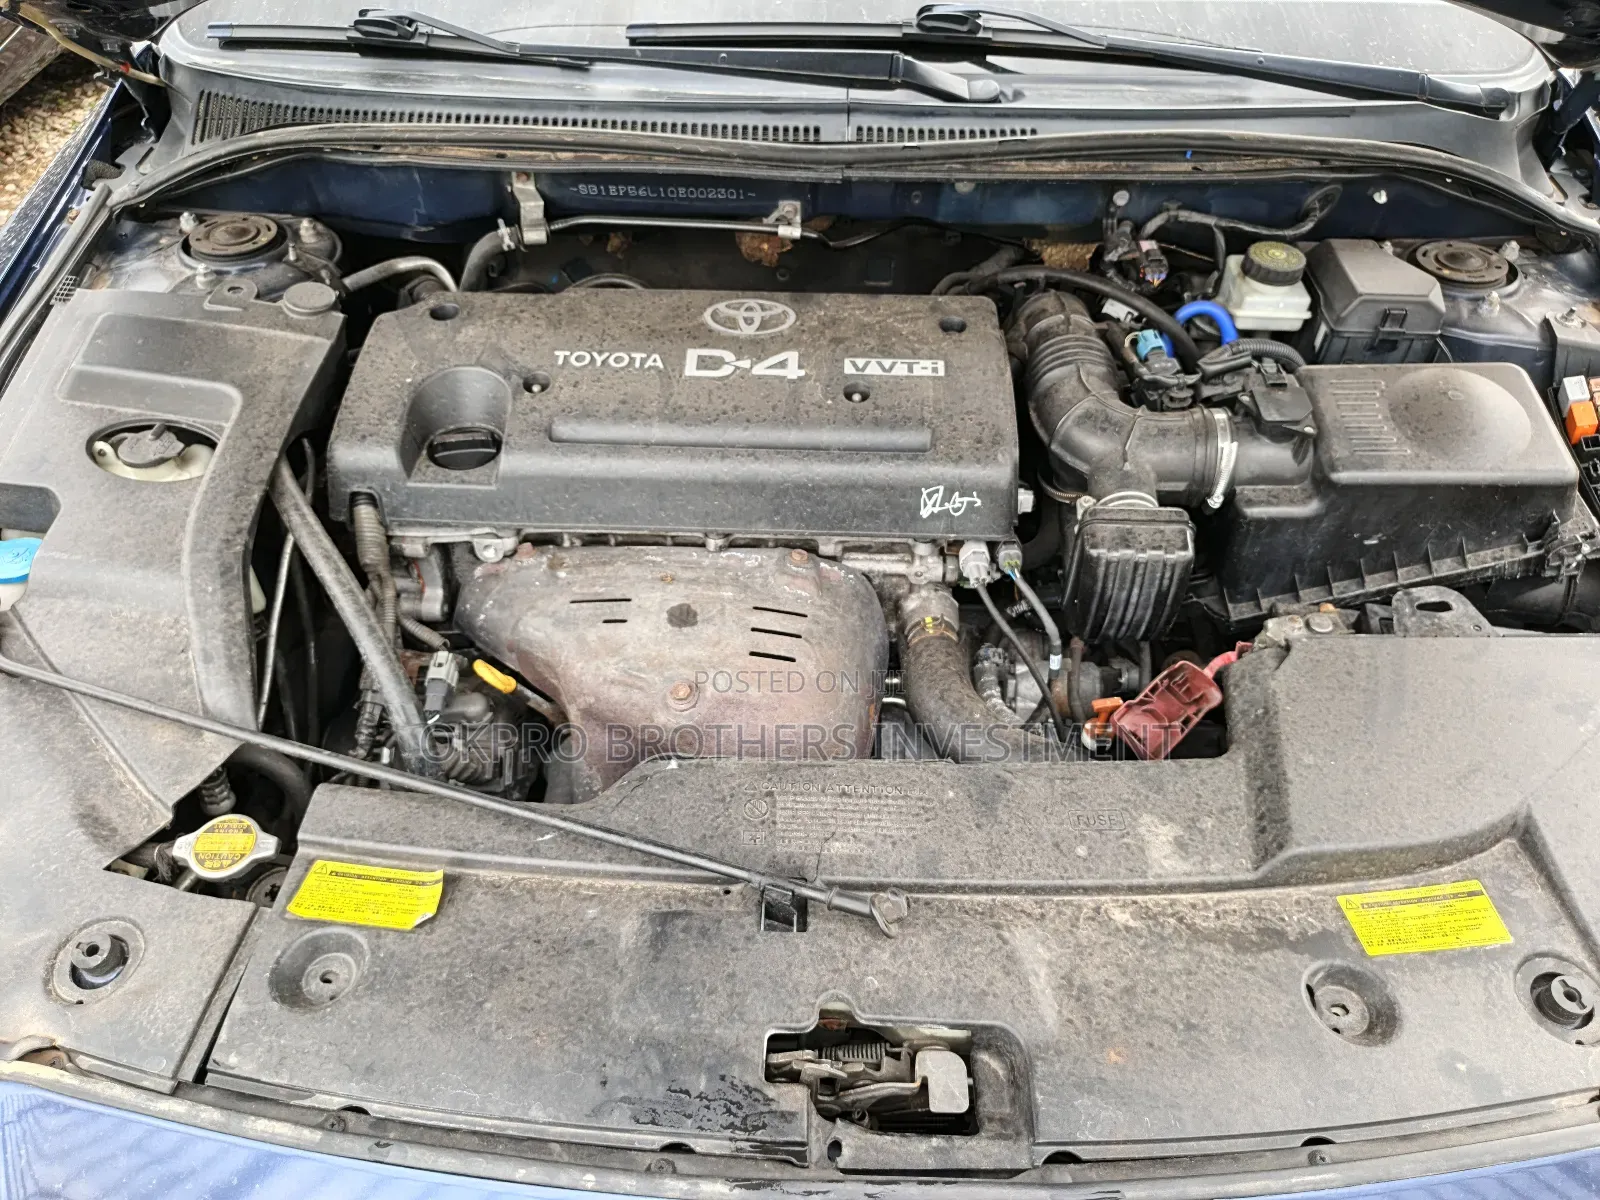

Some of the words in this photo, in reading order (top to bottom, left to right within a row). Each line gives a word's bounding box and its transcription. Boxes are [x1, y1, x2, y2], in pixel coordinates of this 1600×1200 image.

[554, 350, 664, 370] TOYOTA
[684, 348, 805, 380] D-4
[761, 782, 821, 792] CAUTION
[826, 784, 903, 795] ATTENTION
[1076, 814, 1117, 827] FUSE
[197, 852, 242, 861] CAUTION
